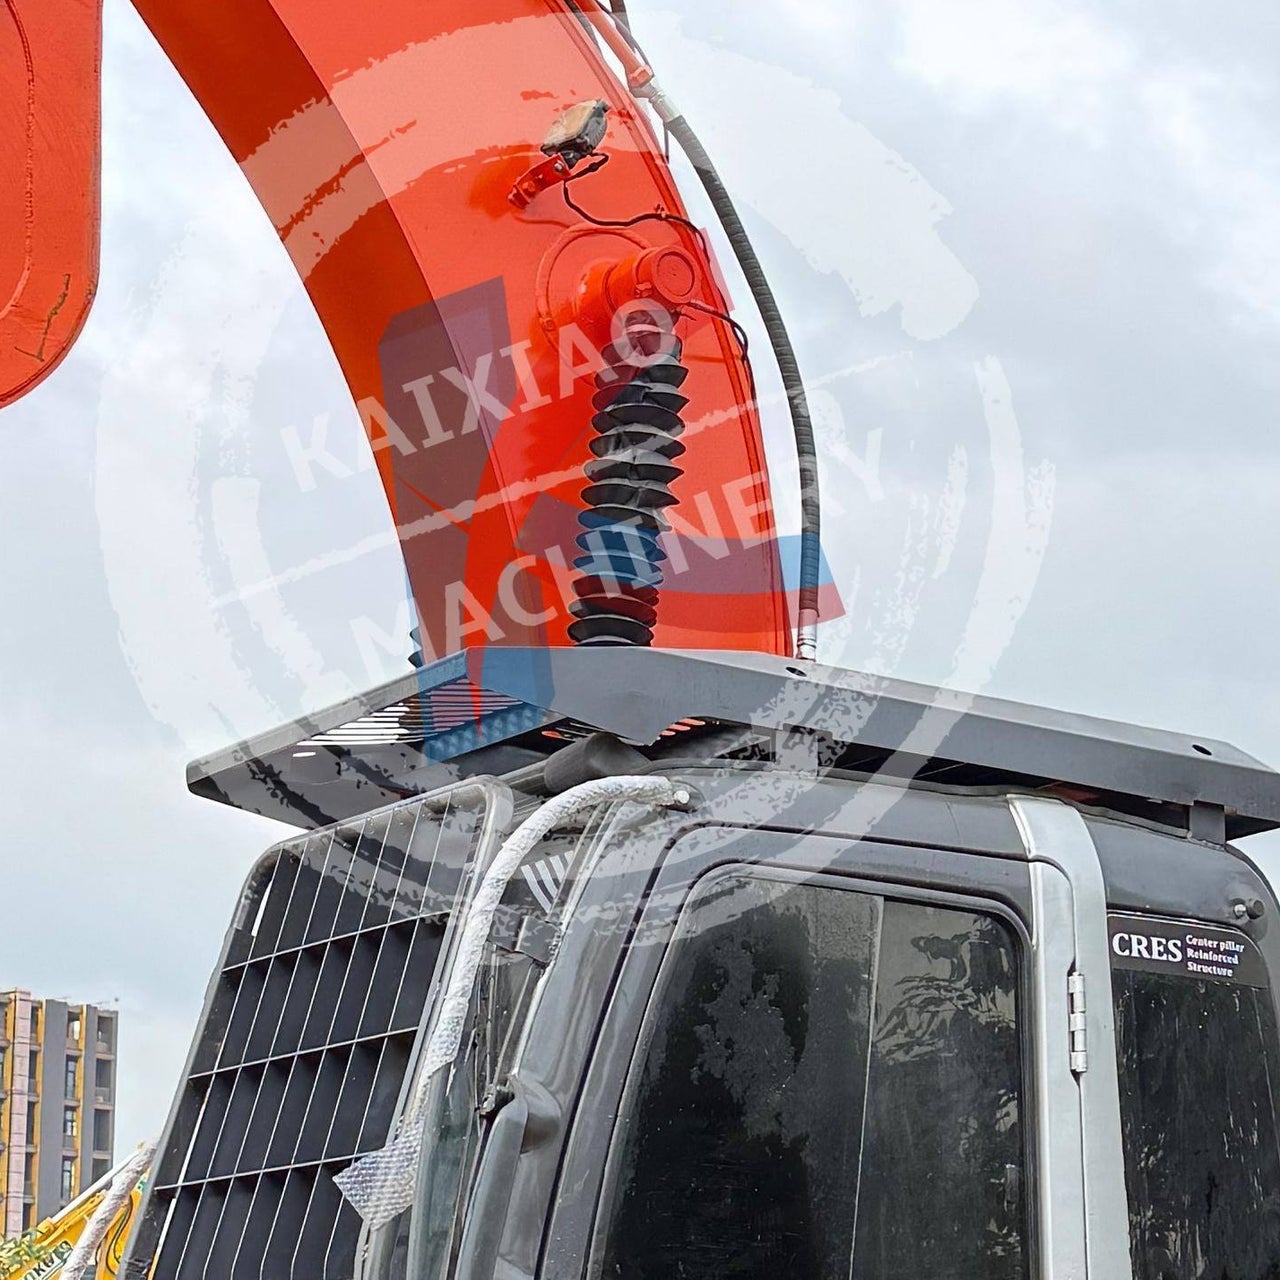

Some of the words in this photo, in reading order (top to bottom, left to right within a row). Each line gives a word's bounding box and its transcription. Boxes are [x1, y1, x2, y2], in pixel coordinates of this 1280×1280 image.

[1112, 932, 1183, 963] CRES
[1185, 934, 1219, 950] Center
[1186, 948, 1239, 965] Reinforced
[1187, 961, 1234, 977] Structure
